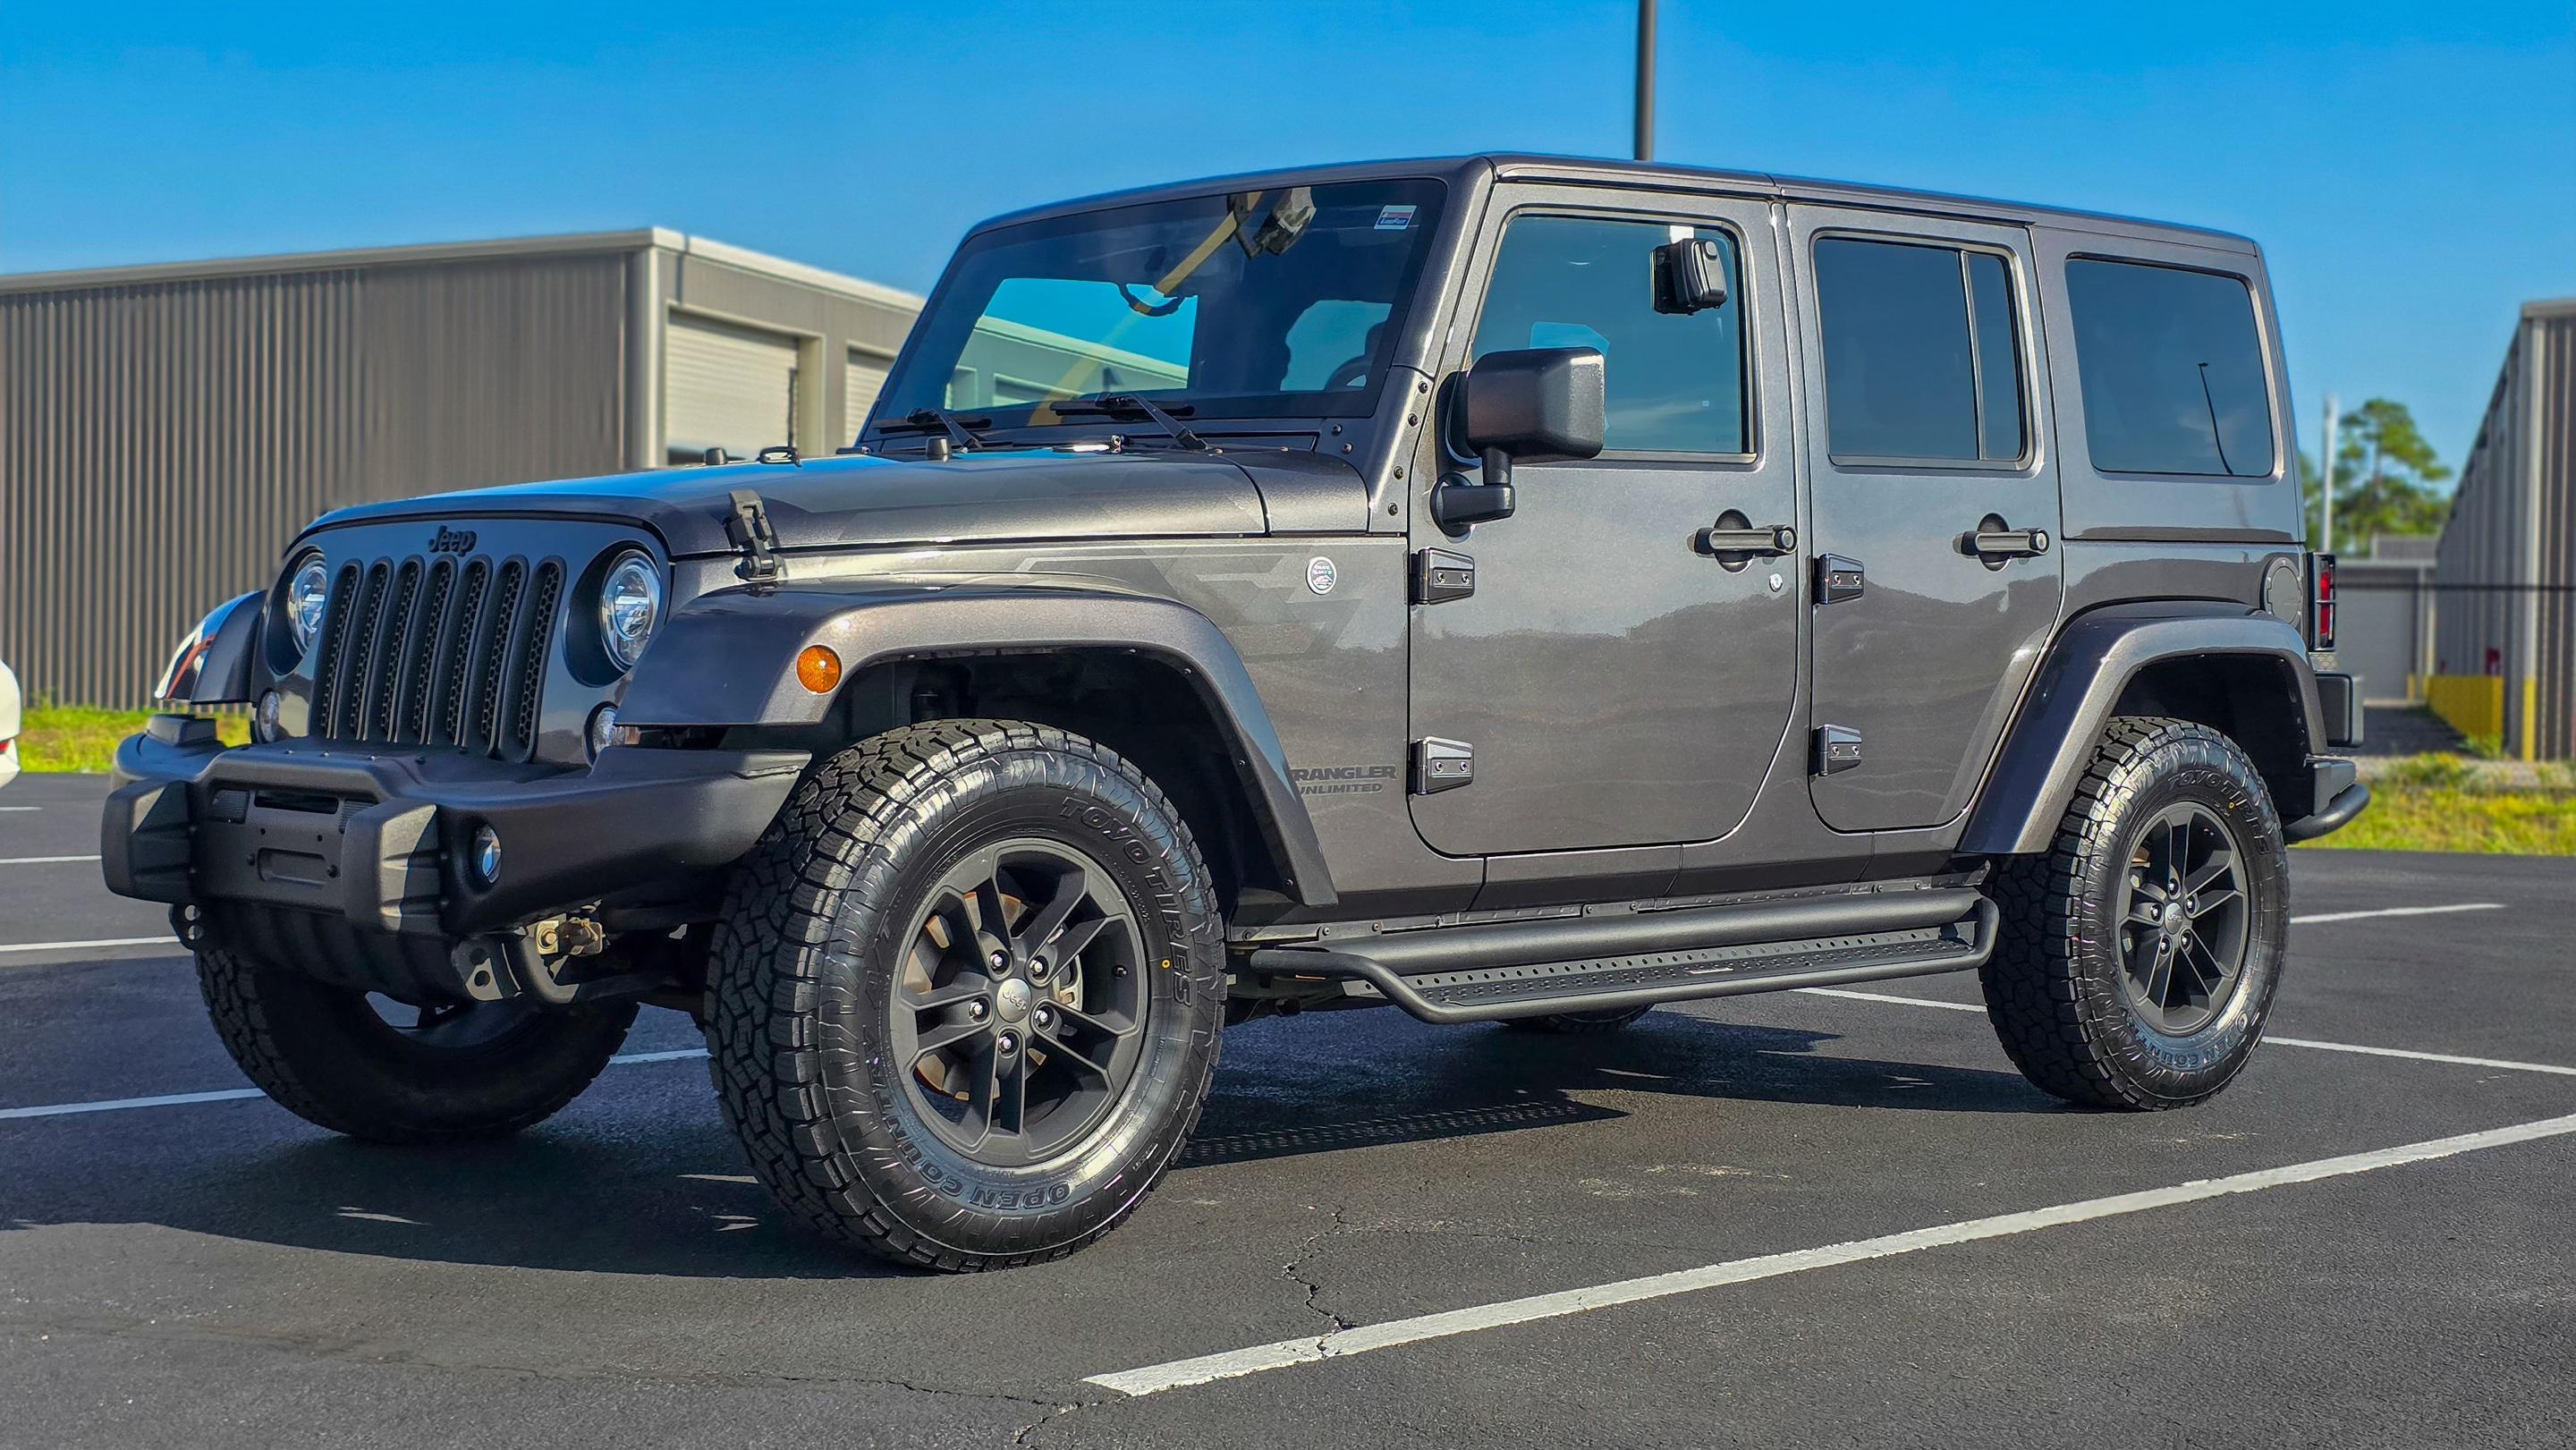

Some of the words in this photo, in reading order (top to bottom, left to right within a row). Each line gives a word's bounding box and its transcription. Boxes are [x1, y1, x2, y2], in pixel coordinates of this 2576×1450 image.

[428, 525, 478, 557] Jeep
[1290, 767, 1397, 781] RANGLER
[1059, 796, 1152, 864] TOYO
[1145, 865, 1194, 1008] TIRES
[1002, 988, 1028, 1012] Jeep
[862, 1023, 964, 1197] COUNTRY
[968, 1181, 1072, 1210] OPEN
